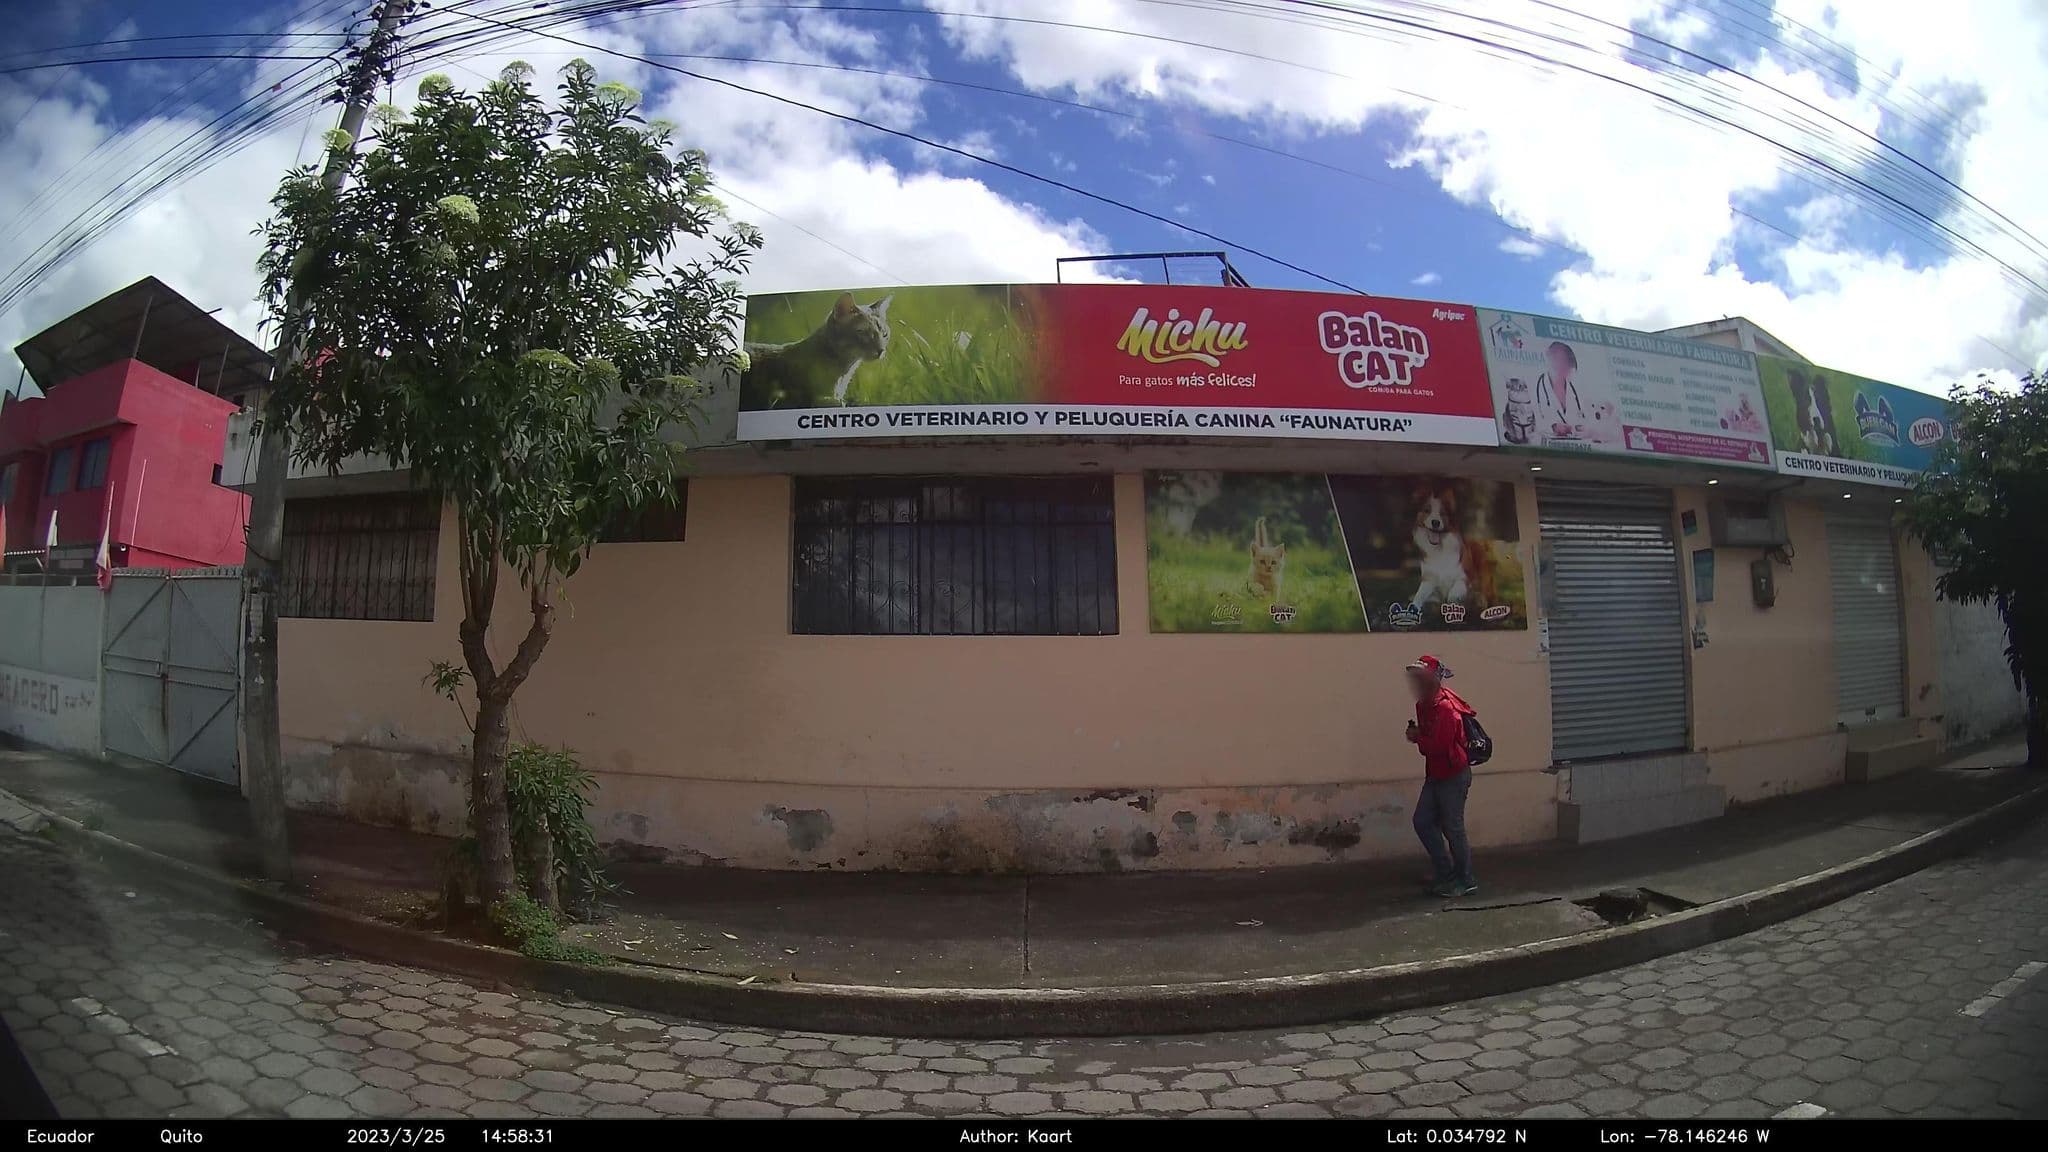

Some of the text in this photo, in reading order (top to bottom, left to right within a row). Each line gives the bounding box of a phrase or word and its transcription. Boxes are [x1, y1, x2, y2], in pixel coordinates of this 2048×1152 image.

[1117, 307, 1248, 367] Michu
[1322, 315, 1425, 355] Balan
[1550, 323, 1601, 344] CENTRO
[1602, 332, 1687, 357] VETERINARIO
[1343, 350, 1410, 383] CAT
[1119, 372, 1257, 387] Para gatos más felices!
[1395, 387, 1412, 396] PARA
[1413, 389, 1434, 397] GATOS
[797, 413, 880, 429] CENTRO
[885, 411, 1029, 427] VETERINARIO
[1034, 411, 1049, 425] Y
[1055, 409, 1189, 428] PELUQUERÍA
[1195, 413, 1275, 429] CANINA
[1913, 421, 1940, 440] ALCON
[1785, 456, 1822, 471] CENTRO
[1823, 462, 1876, 479] VETERINARIO
[1877, 469, 1884, 479] Y
[1484, 606, 1507, 617] ALCON
